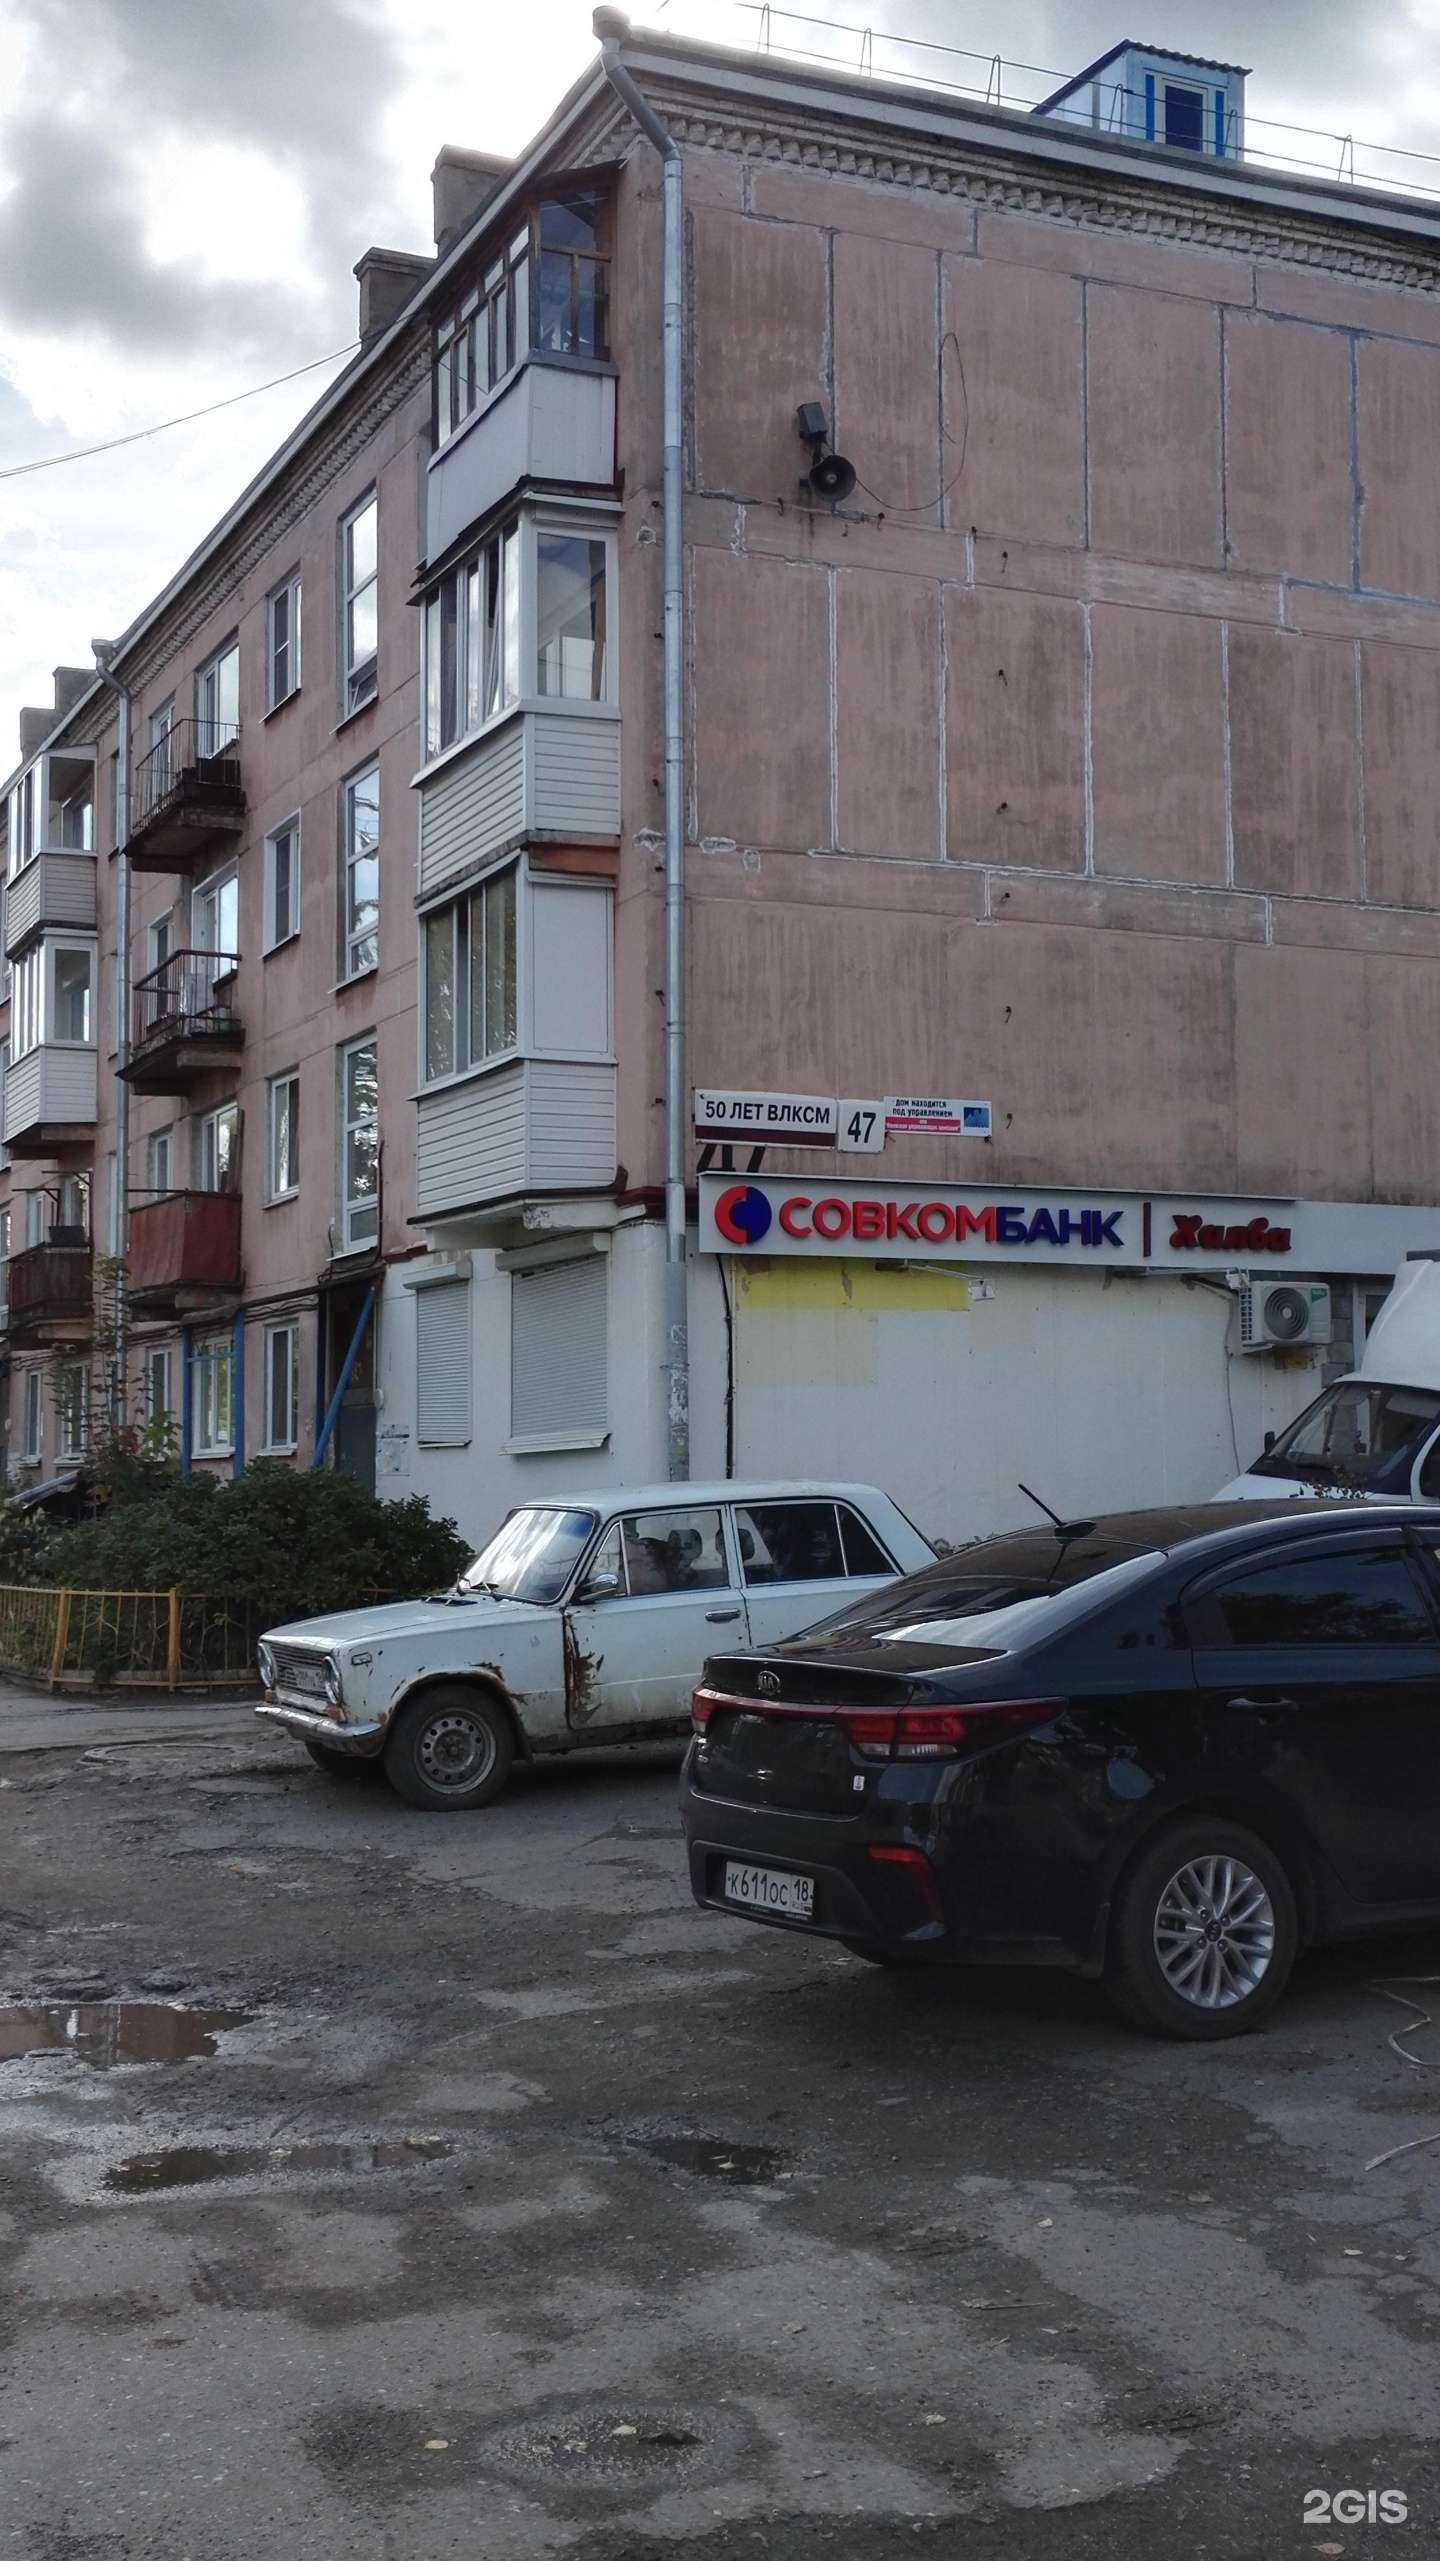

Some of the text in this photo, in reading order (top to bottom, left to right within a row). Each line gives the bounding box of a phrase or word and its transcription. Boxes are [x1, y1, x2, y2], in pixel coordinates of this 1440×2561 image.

[705, 1101, 830, 1124] 50 ЛЕТ ВЛКСМ
[847, 1111, 876, 1143] 47
[779, 1196, 1124, 1247] СОВКОМБАНК
